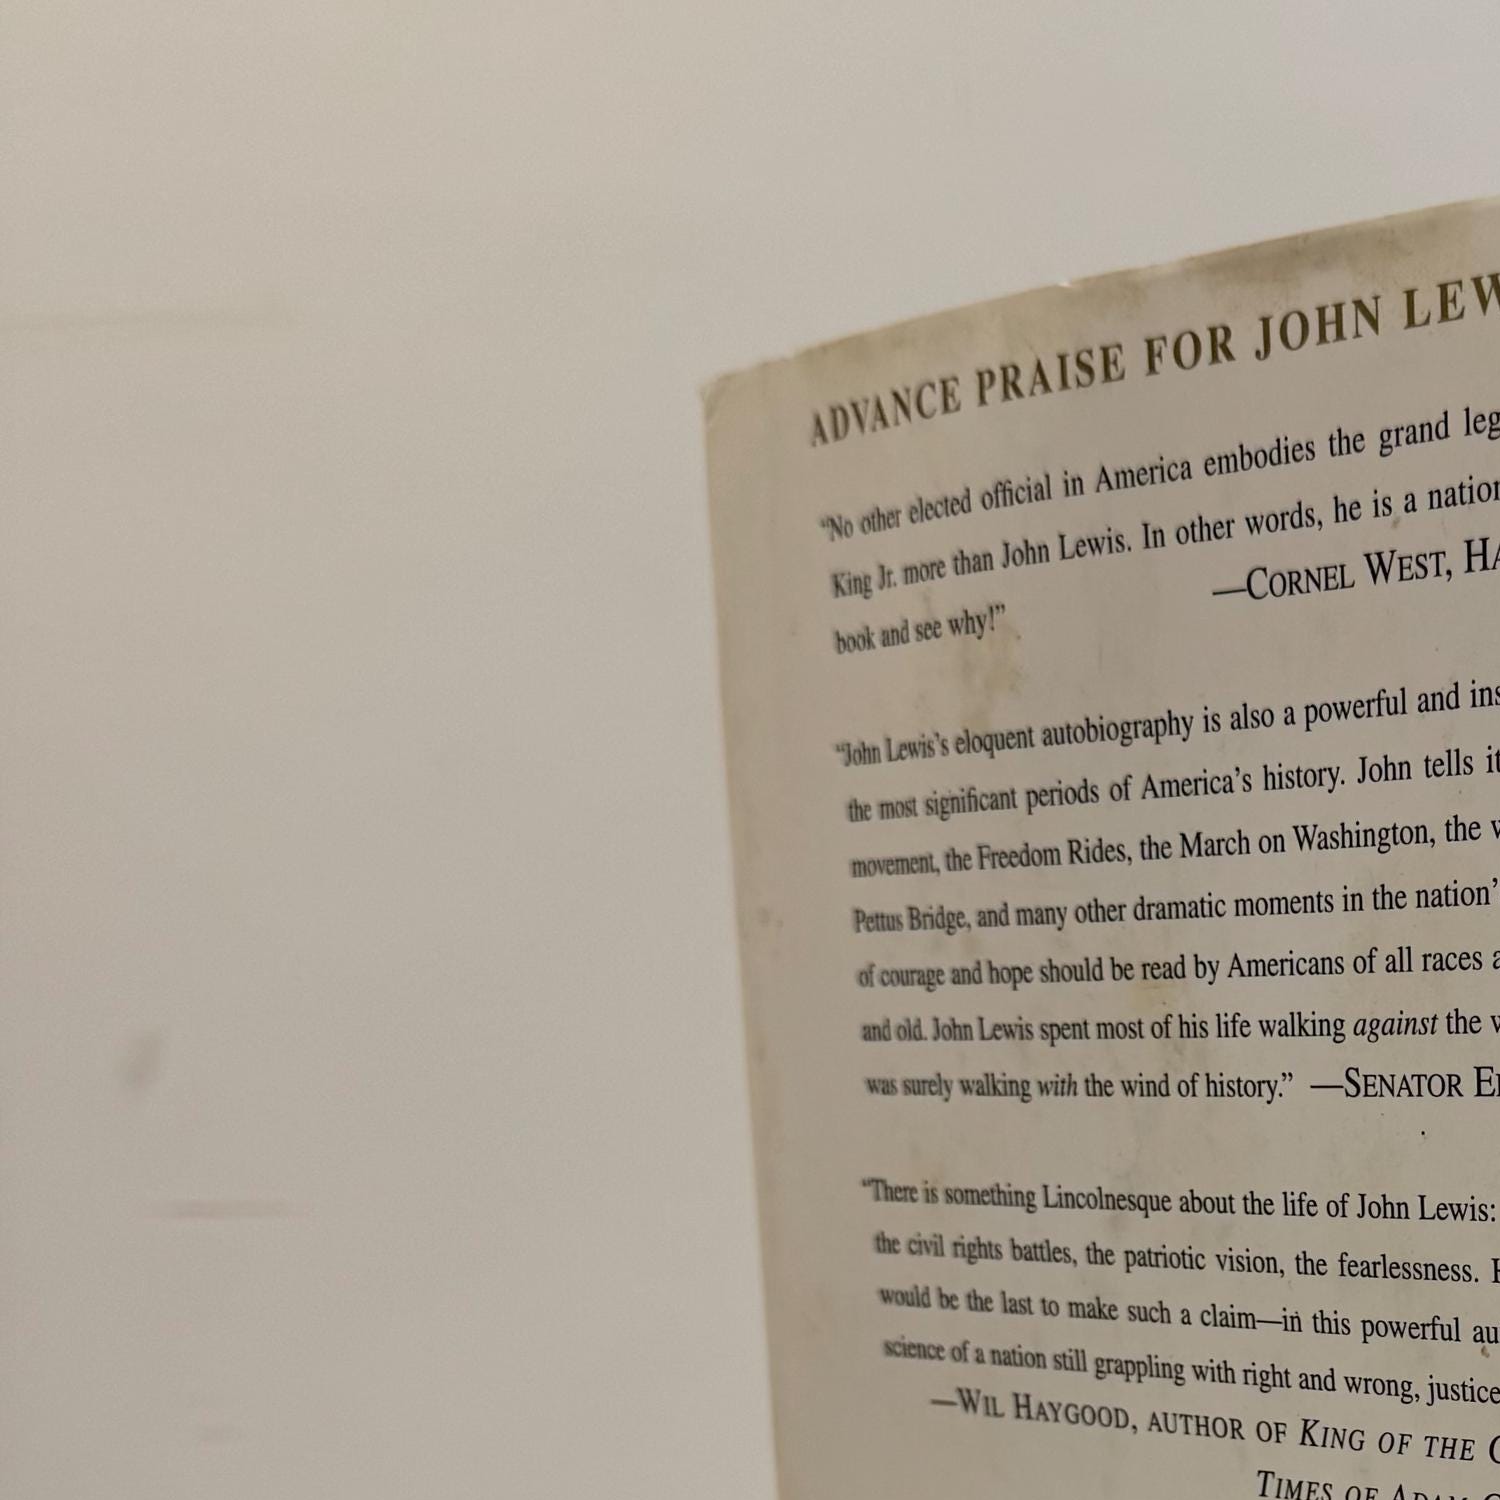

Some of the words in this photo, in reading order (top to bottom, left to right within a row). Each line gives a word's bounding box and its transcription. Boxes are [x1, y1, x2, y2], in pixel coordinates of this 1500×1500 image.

[810, 374, 961, 447] ADVANCE
[975, 342, 1125, 407] PRAISE
[1144, 323, 1236, 376] FOR
[1255, 294, 1381, 361] JOHN
[1379, 409, 1451, 458] grand
[1372, 488, 1392, 518] is
[1404, 491, 1418, 514] a
[1363, 547, 1452, 586] WEST,
[832, 623, 876, 655] book
[878, 616, 910, 648] and
[913, 617, 943, 642] see
[1418, 680, 1460, 713] and
[1357, 754, 1412, 784] John
[1424, 748, 1474, 779] tells
[1443, 814, 1482, 842] the
[1369, 883, 1407, 911] the
[1385, 945, 1414, 973] all
[1421, 951, 1483, 973] races
[1444, 1008, 1482, 1035] the
[1356, 1193, 1411, 1220] John
[1417, 1194, 1496, 1222] Lewis:
[1360, 1315, 1462, 1344] powerful
[1011, 1392, 1138, 1435] HAYGOOD,
[1147, 1411, 1246, 1440] AUTHOR
[1256, 1420, 1287, 1444] OF
[1298, 1418, 1365, 1451] KING
[1378, 1432, 1412, 1455] OF
[1424, 1436, 1475, 1461] THE
